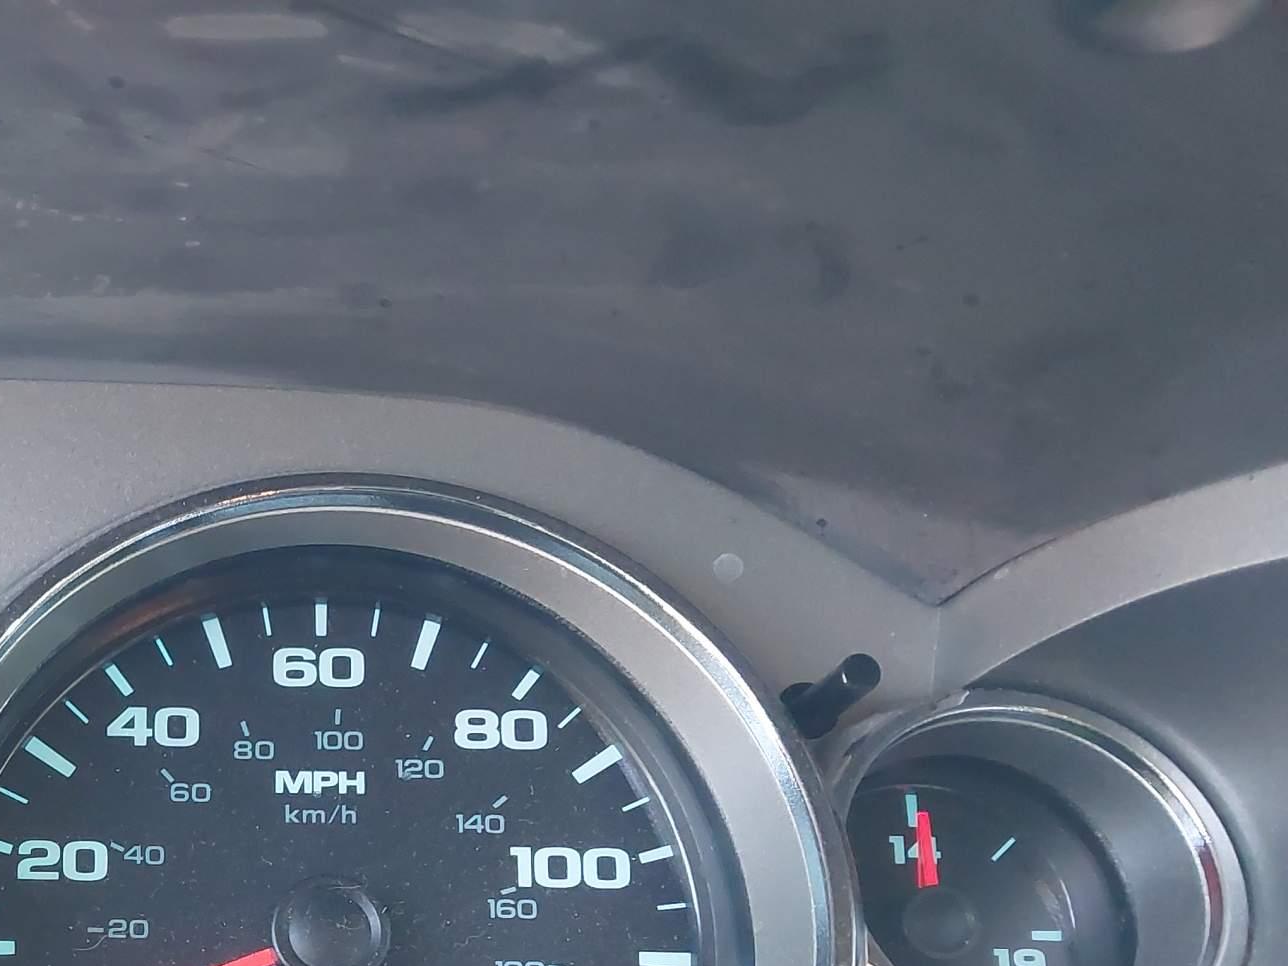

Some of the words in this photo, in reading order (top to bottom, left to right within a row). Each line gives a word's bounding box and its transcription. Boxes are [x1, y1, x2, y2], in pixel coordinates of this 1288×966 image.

[272, 648, 366, 688] 60
[107, 707, 199, 747] 40
[454, 710, 548, 750] 80
[234, 741, 274, 760] 80
[315, 731, 364, 751] 100
[396, 758, 444, 779] 120
[274, 770, 366, 794] MPH
[170, 783, 211, 803] 60
[284, 804, 357, 825] km/h
[456, 814, 505, 834] 140
[17, 841, 108, 882] 20
[123, 845, 165, 865] 40
[509, 847, 630, 890] 100
[488, 899, 537, 919] 160
[107, 919, 149, 939] 20
